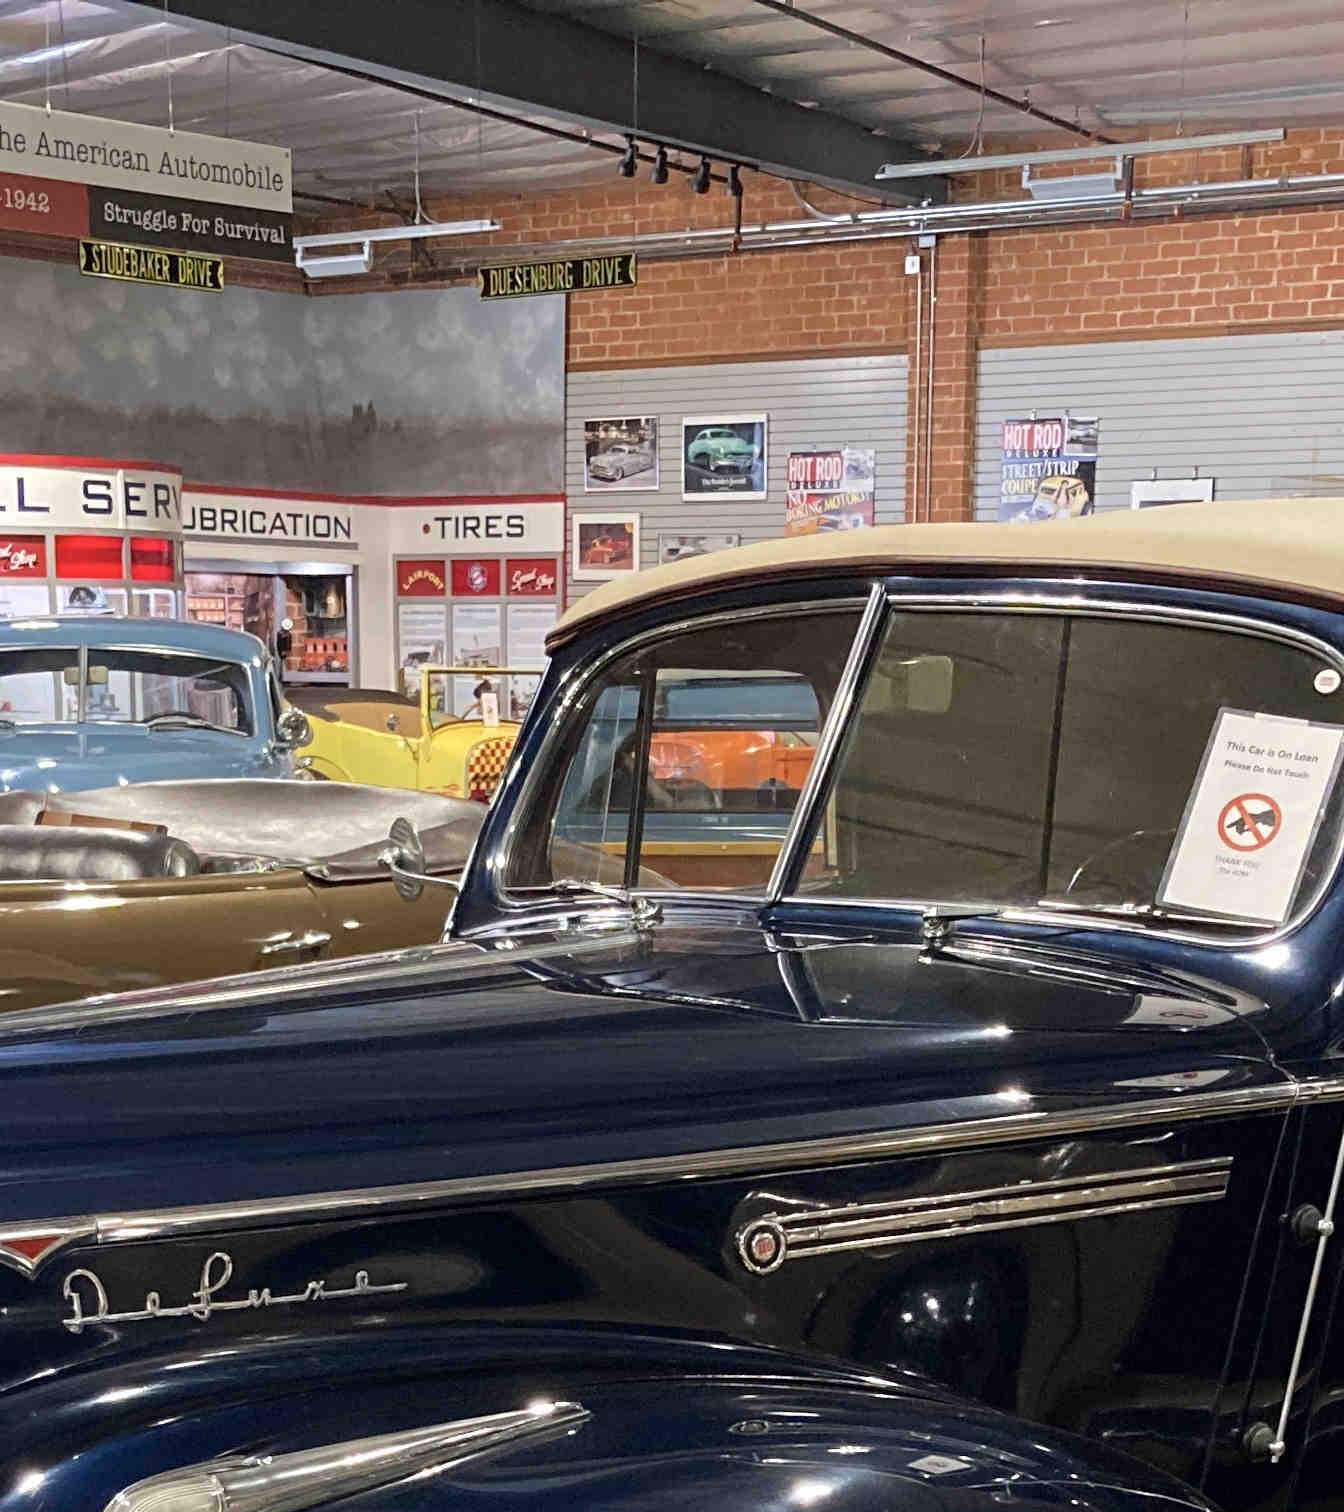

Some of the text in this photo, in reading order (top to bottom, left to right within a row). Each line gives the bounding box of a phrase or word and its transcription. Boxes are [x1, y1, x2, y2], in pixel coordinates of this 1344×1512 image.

[36, 131, 150, 173] American
[158, 151, 284, 192] Automobile
[103, 201, 286, 244] Struggle For Survival
[91, 245, 213, 286] STUDEBAKER DRIVE
[489, 257, 624, 296] DUESENBURG DRIVE
[1003, 423, 1062, 450] HOT ROD
[789, 456, 842, 482] HOT ROD
[1001, 459, 1079, 480] STREET/STRIP
[1001, 478, 1040, 495] COUPE
[434, 515, 525, 539] TIRES
[9, 549, 38, 571] Shop
[1226, 741, 1320, 763] This Car is On Loan
[1224, 759, 1311, 779] Please Do Not Touch
